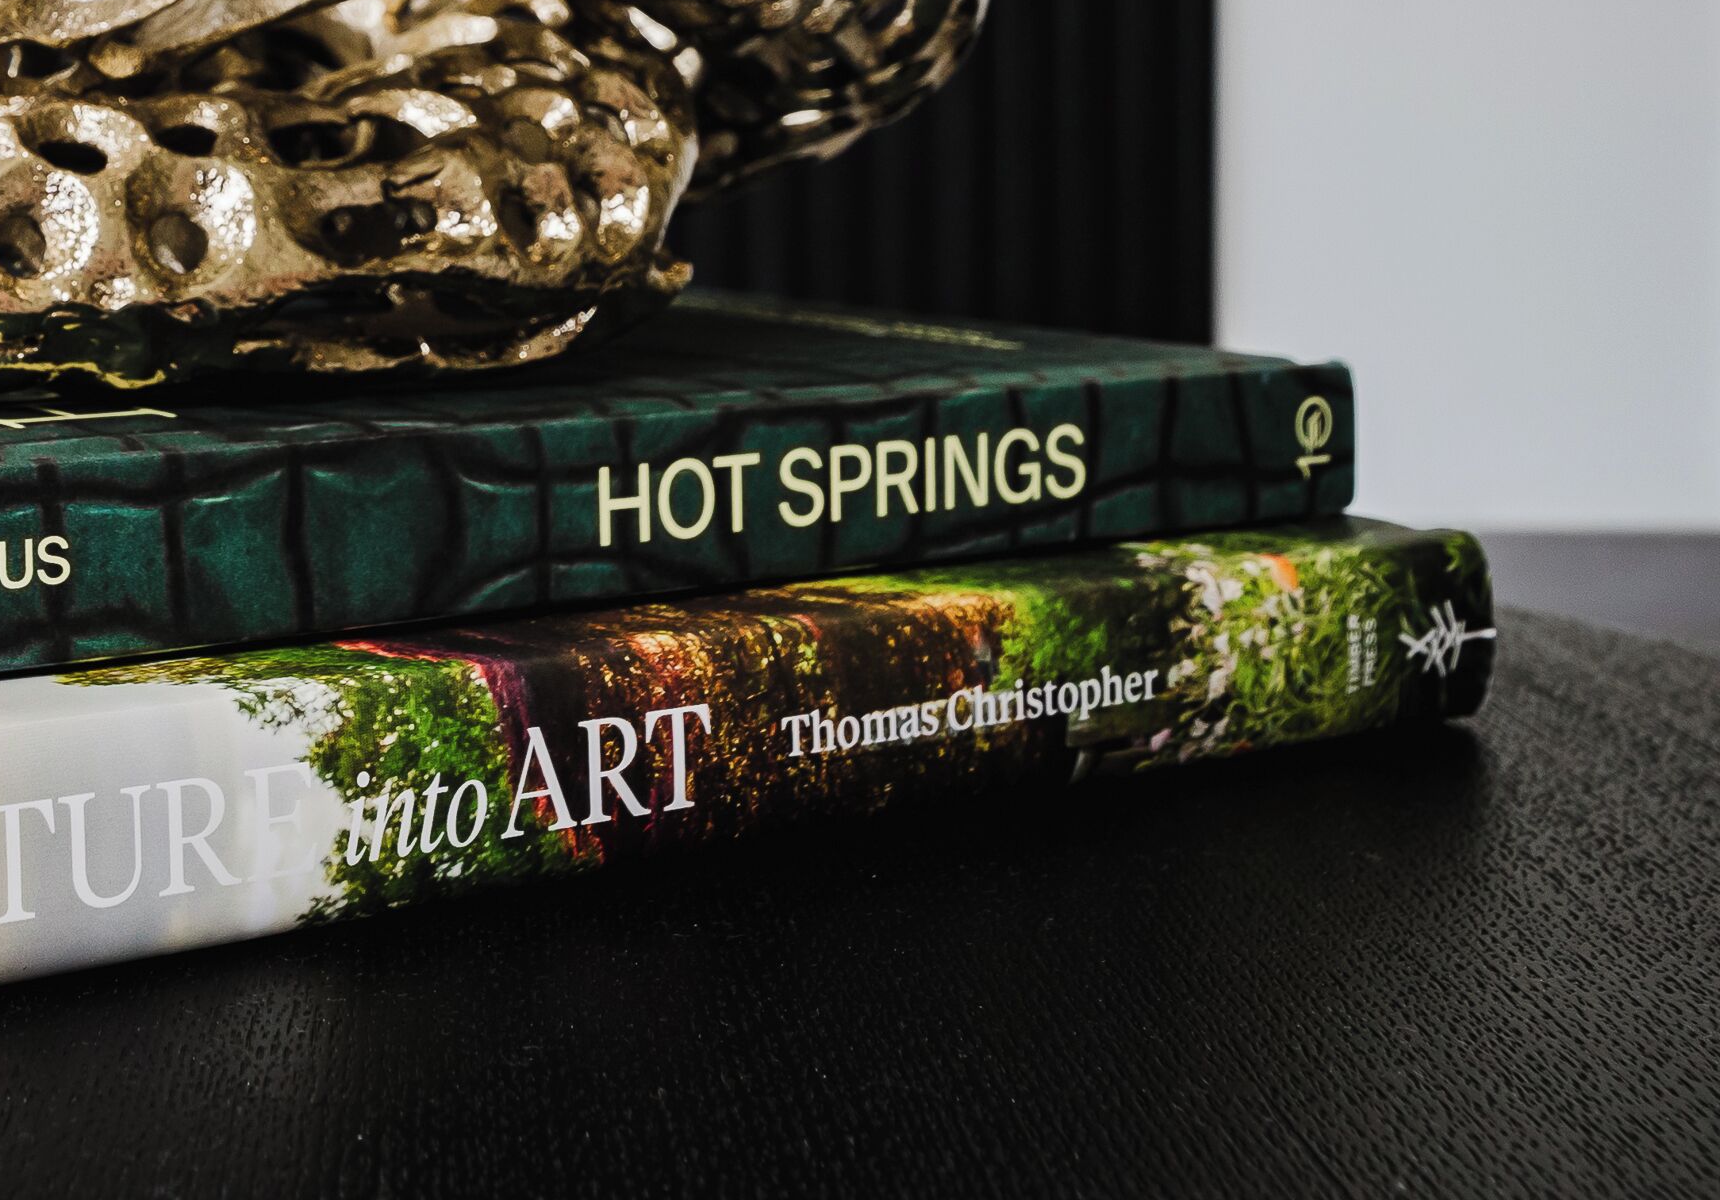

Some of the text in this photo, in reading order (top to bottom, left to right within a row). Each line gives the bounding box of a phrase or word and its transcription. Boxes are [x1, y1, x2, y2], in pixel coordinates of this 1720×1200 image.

[598, 422, 1087, 547] HOT SPRINGS
[780, 665, 1160, 758] Thomas Christopher
[345, 770, 488, 867] into
[500, 702, 712, 840] ART
